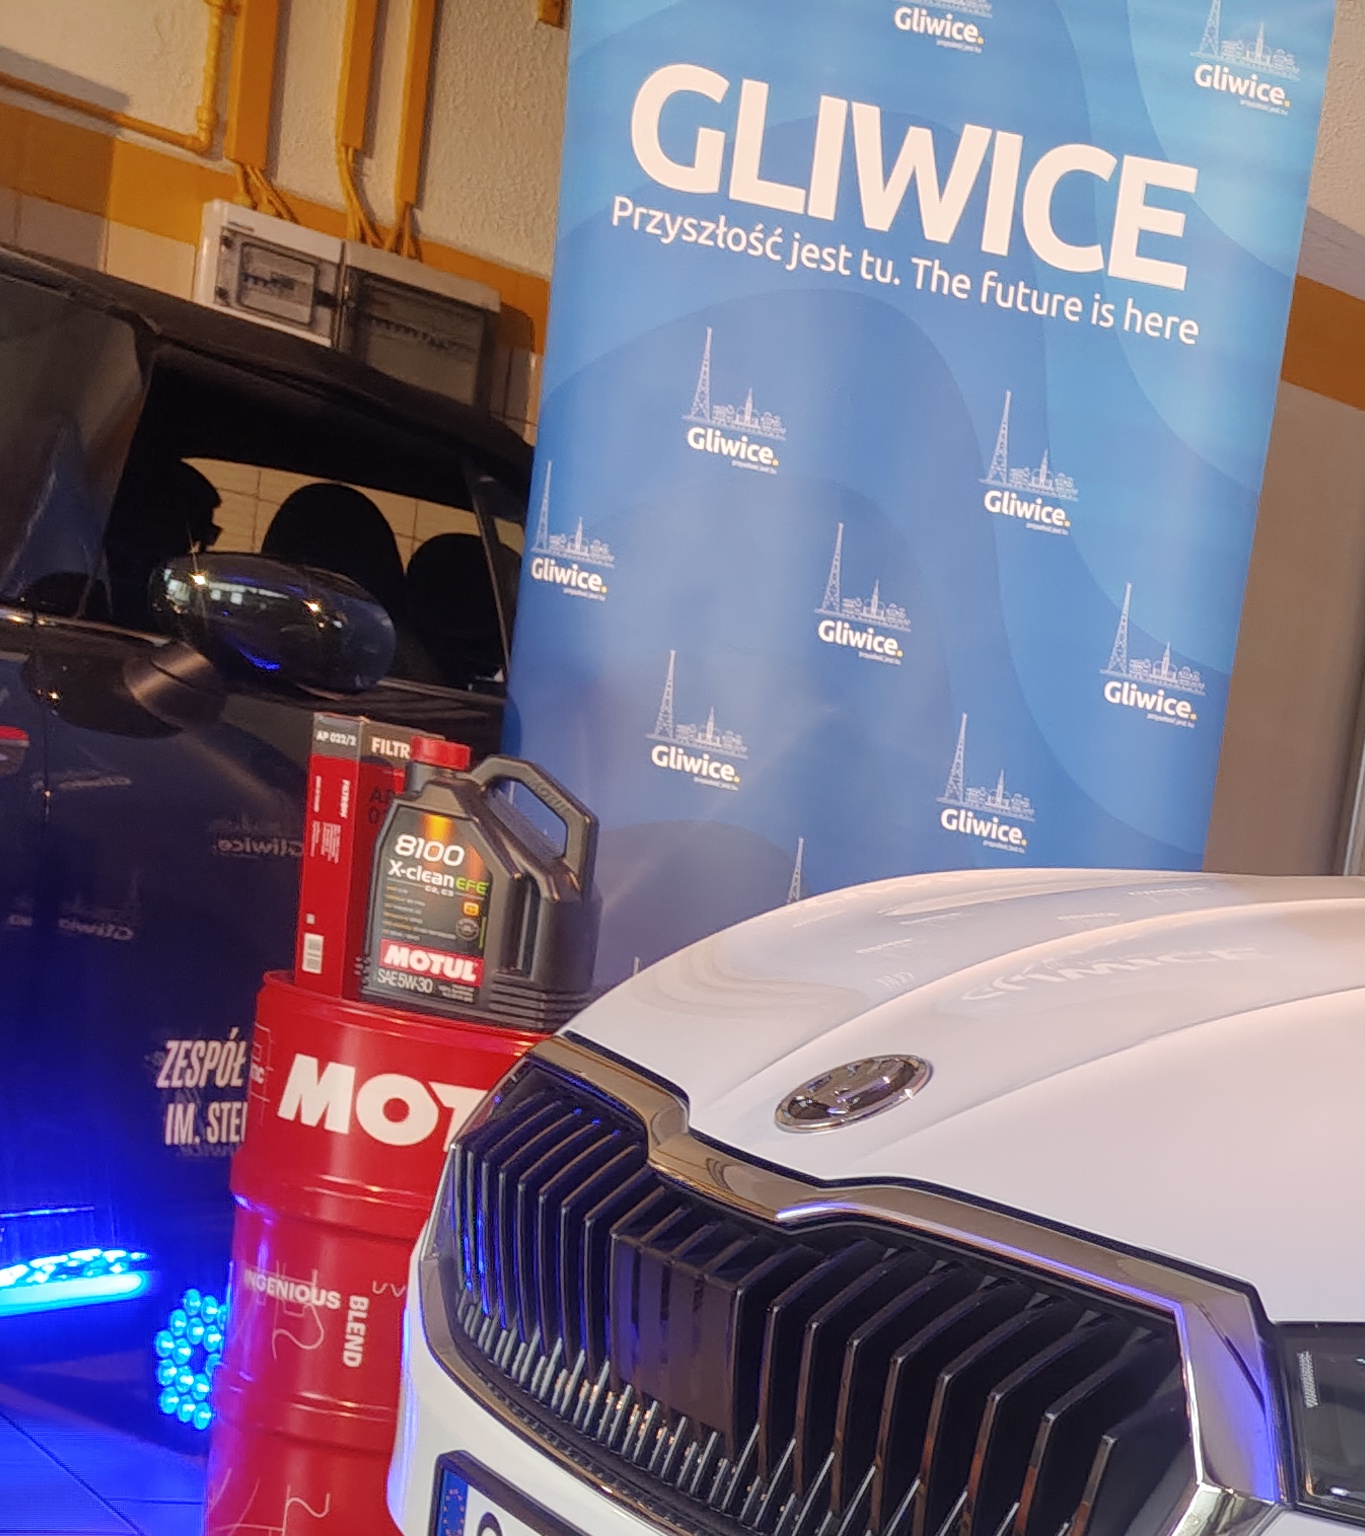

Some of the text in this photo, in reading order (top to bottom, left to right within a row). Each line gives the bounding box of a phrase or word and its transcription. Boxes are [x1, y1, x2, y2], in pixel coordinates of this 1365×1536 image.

[631, 63, 1199, 291] GLIWICE
[612, 195, 1199, 344] Przyszłość jest tu. The future is here
[316, 730, 357, 746] AP 022/2
[395, 834, 465, 866] 8100
[388, 859, 489, 895] X-clean EFE
[377, 969, 398, 987] SAE
[398, 971, 433, 993] 5W-30
[384, 945, 477, 982] MOTUL
[156, 1026, 247, 1088] ZESPÓŁ
[165, 1103, 200, 1145] IM.
[343, 1295, 370, 1368] BLEND
